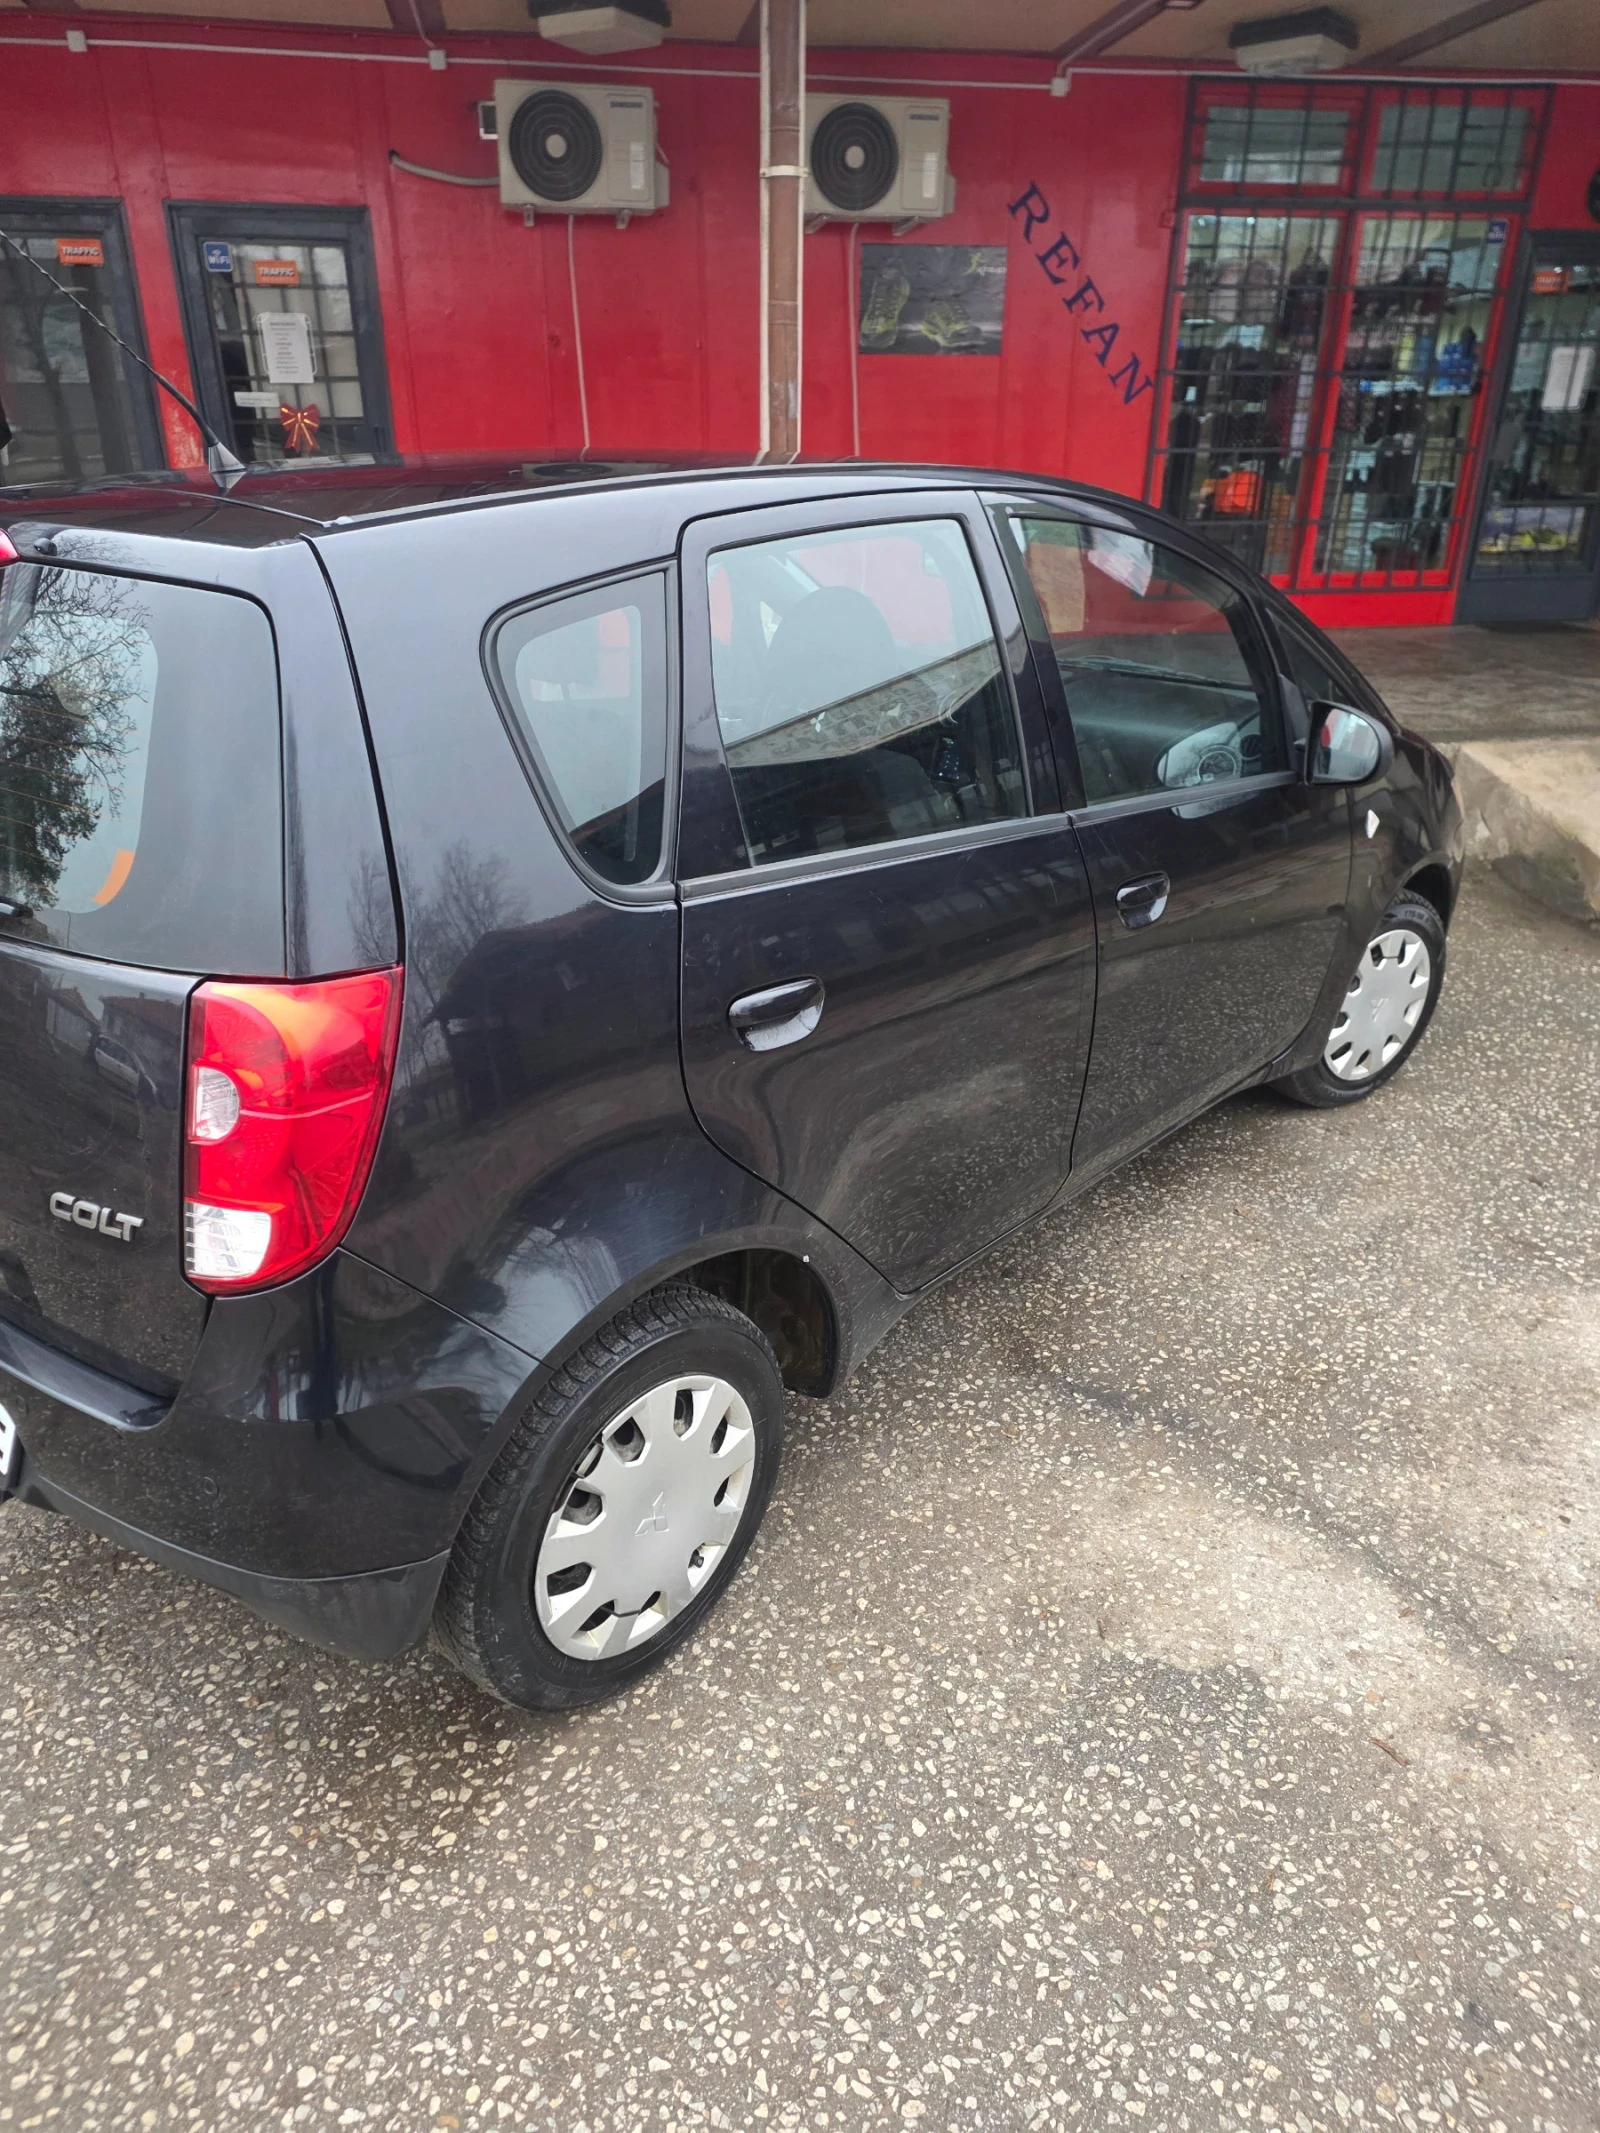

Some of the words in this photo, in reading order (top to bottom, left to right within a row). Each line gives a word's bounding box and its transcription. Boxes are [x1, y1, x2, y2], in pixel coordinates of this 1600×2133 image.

[61, 246, 101, 256] TRAFFIC
[258, 267, 295, 277] TRAFFIC
[1007, 180, 1154, 405] REFAN
[49, 1191, 144, 1242] COLT
